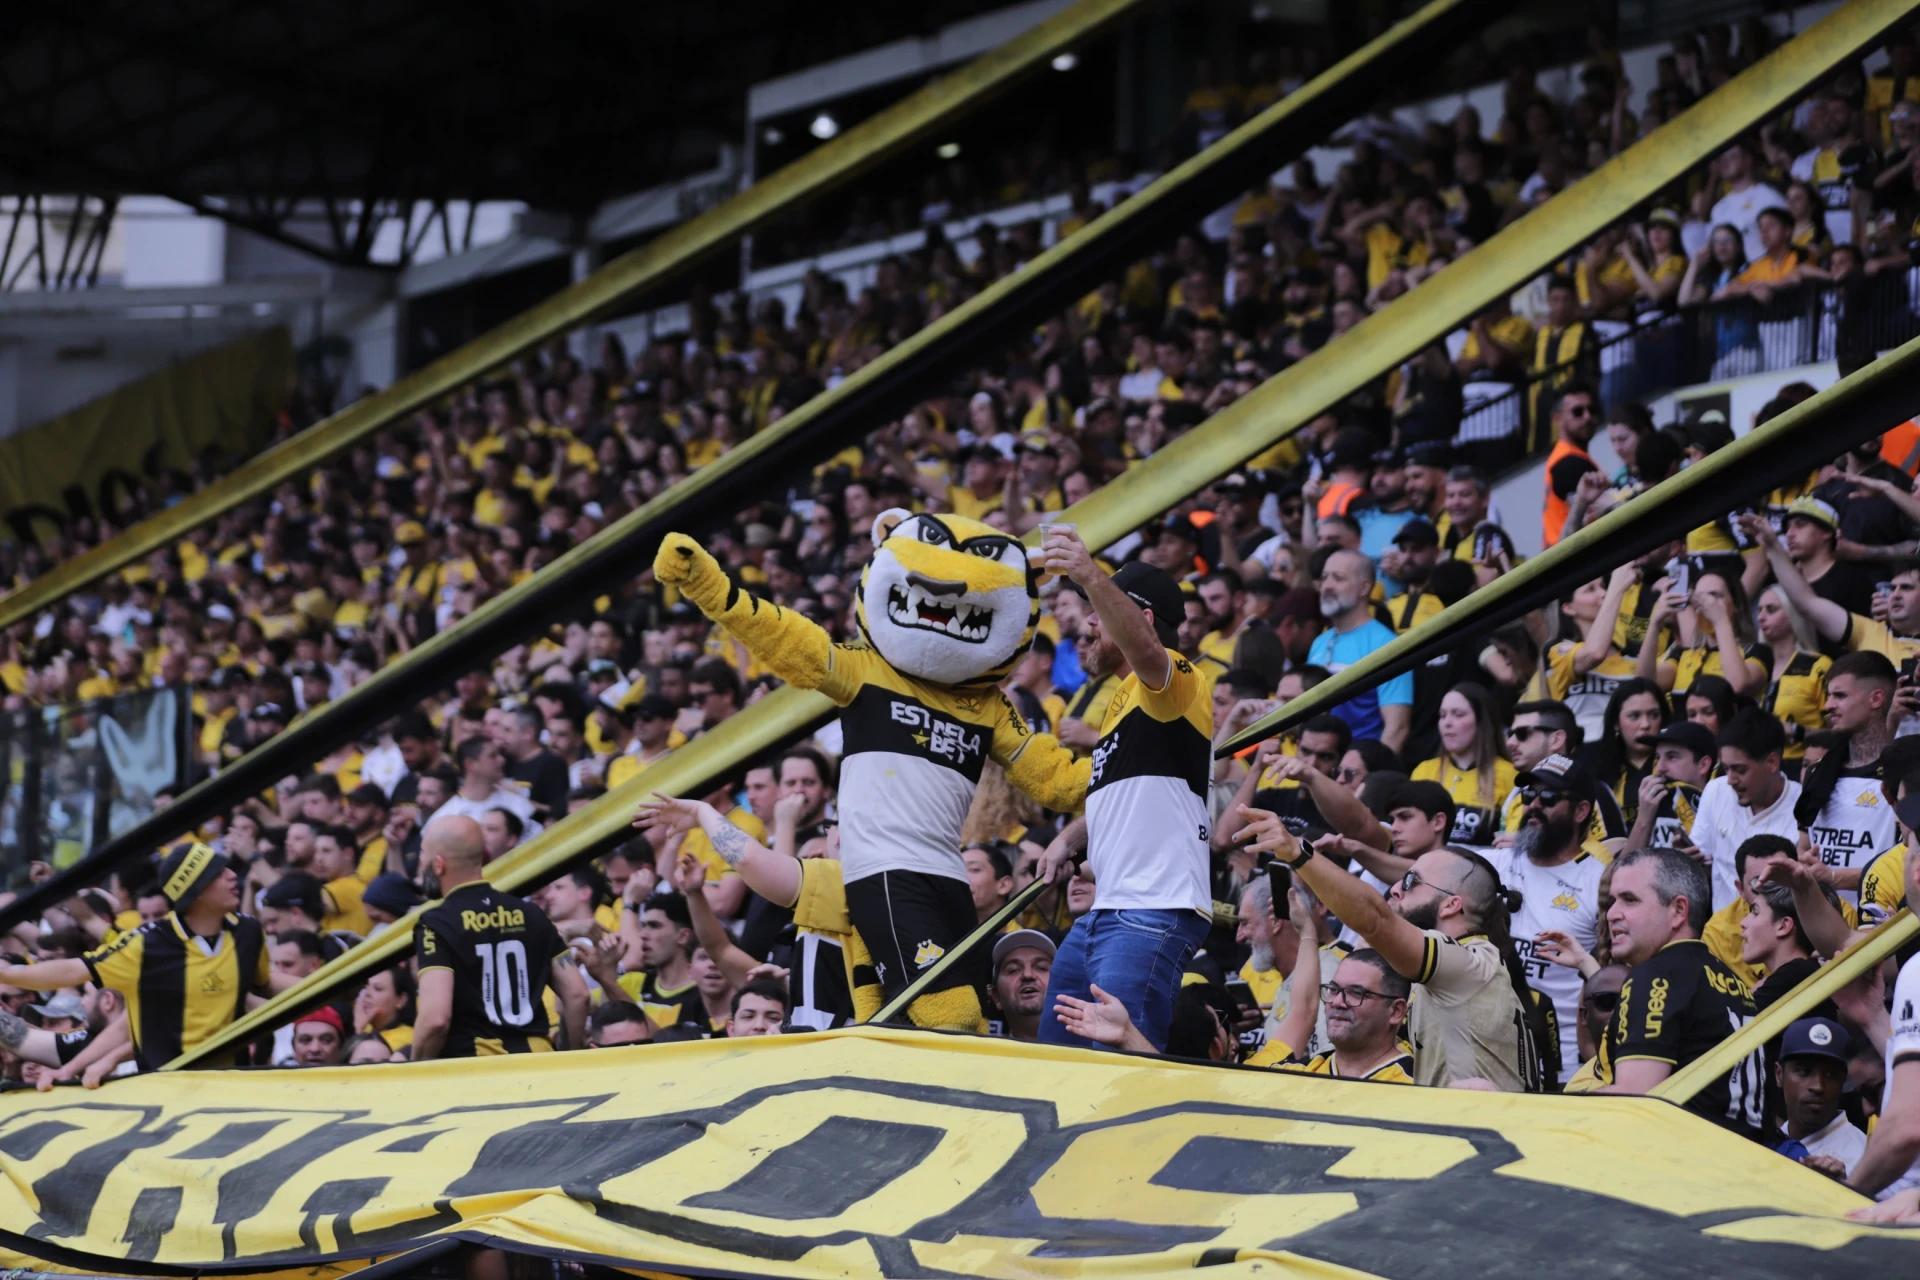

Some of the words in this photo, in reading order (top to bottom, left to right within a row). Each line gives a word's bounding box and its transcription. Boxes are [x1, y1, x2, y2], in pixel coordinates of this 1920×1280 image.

[929, 731, 965, 765] BET
[1821, 849, 1856, 868] BET
[461, 904, 525, 933] Rocha
[475, 939, 535, 1027] 10
[1643, 976, 1670, 1040] unesc
